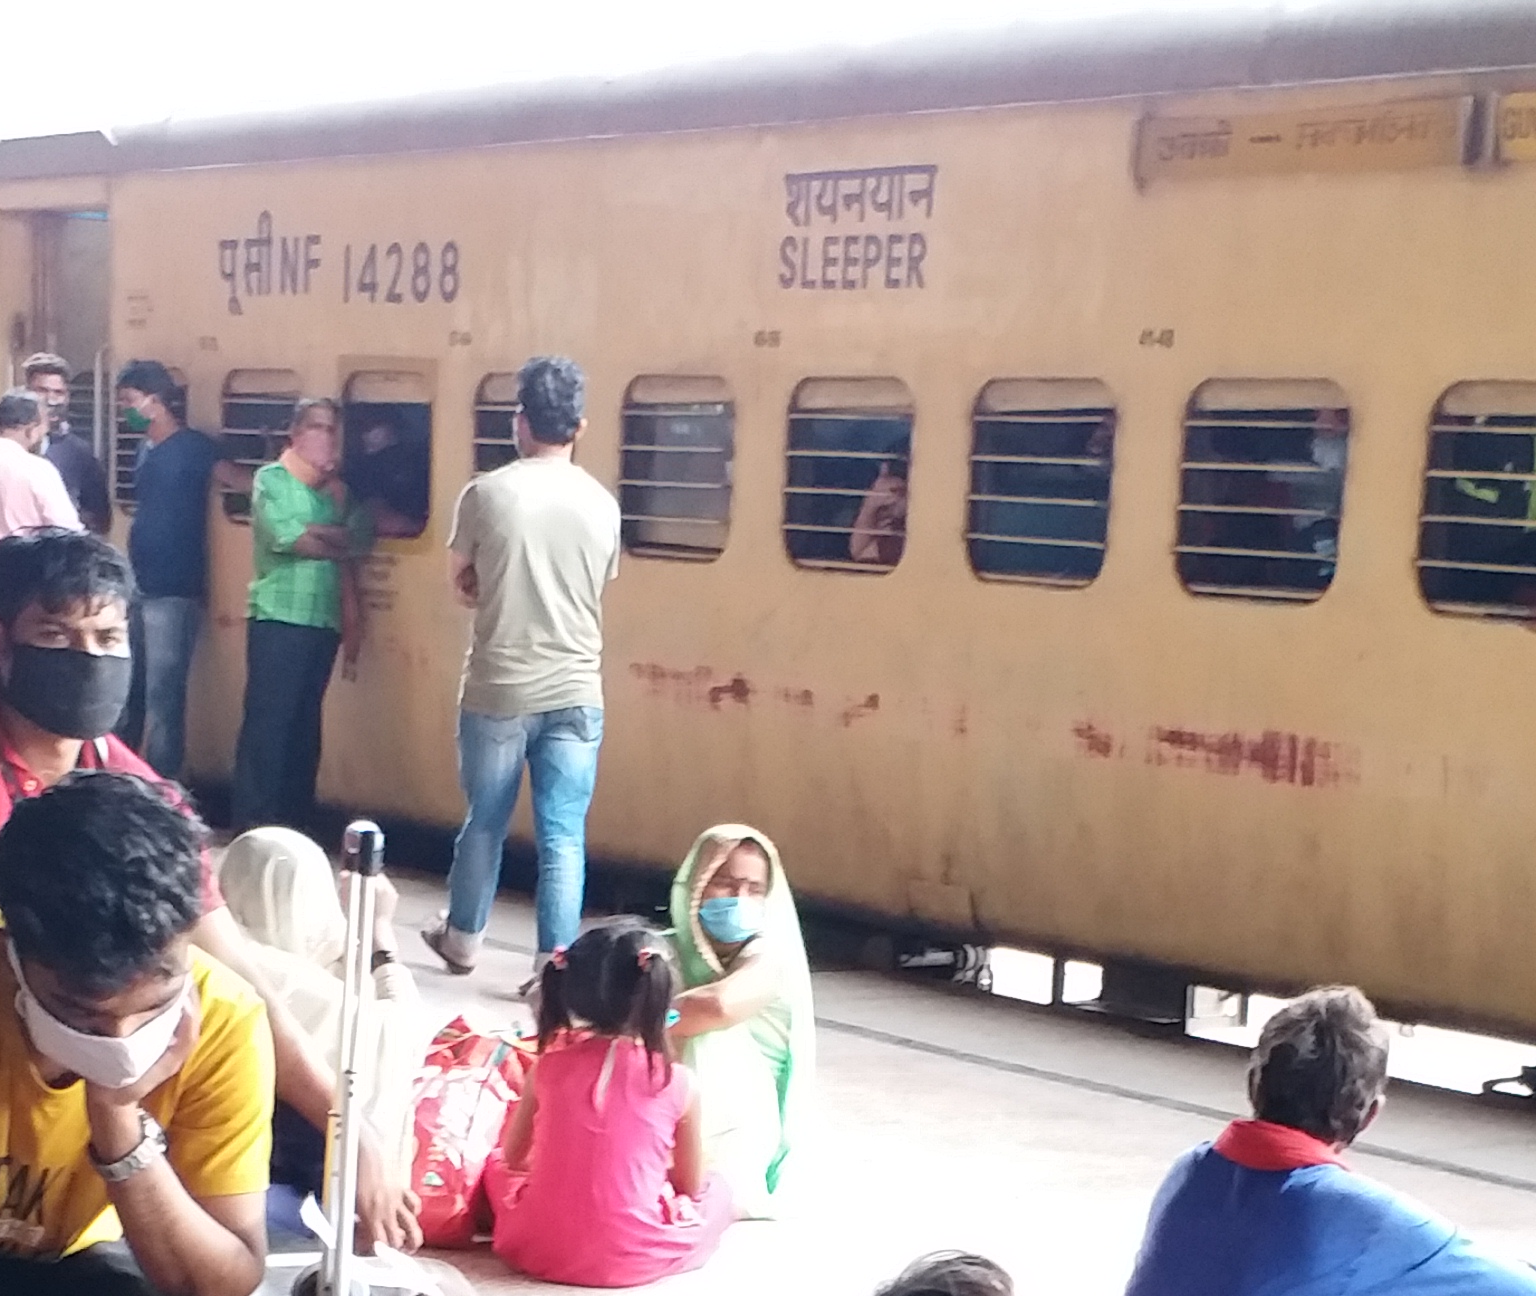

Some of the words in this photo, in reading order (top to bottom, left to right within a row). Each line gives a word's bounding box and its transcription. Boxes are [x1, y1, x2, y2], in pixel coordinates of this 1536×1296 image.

[784, 164, 938, 227] शयनयान
[342, 240, 461, 303] 14288
[778, 231, 927, 290] SLEEPER
